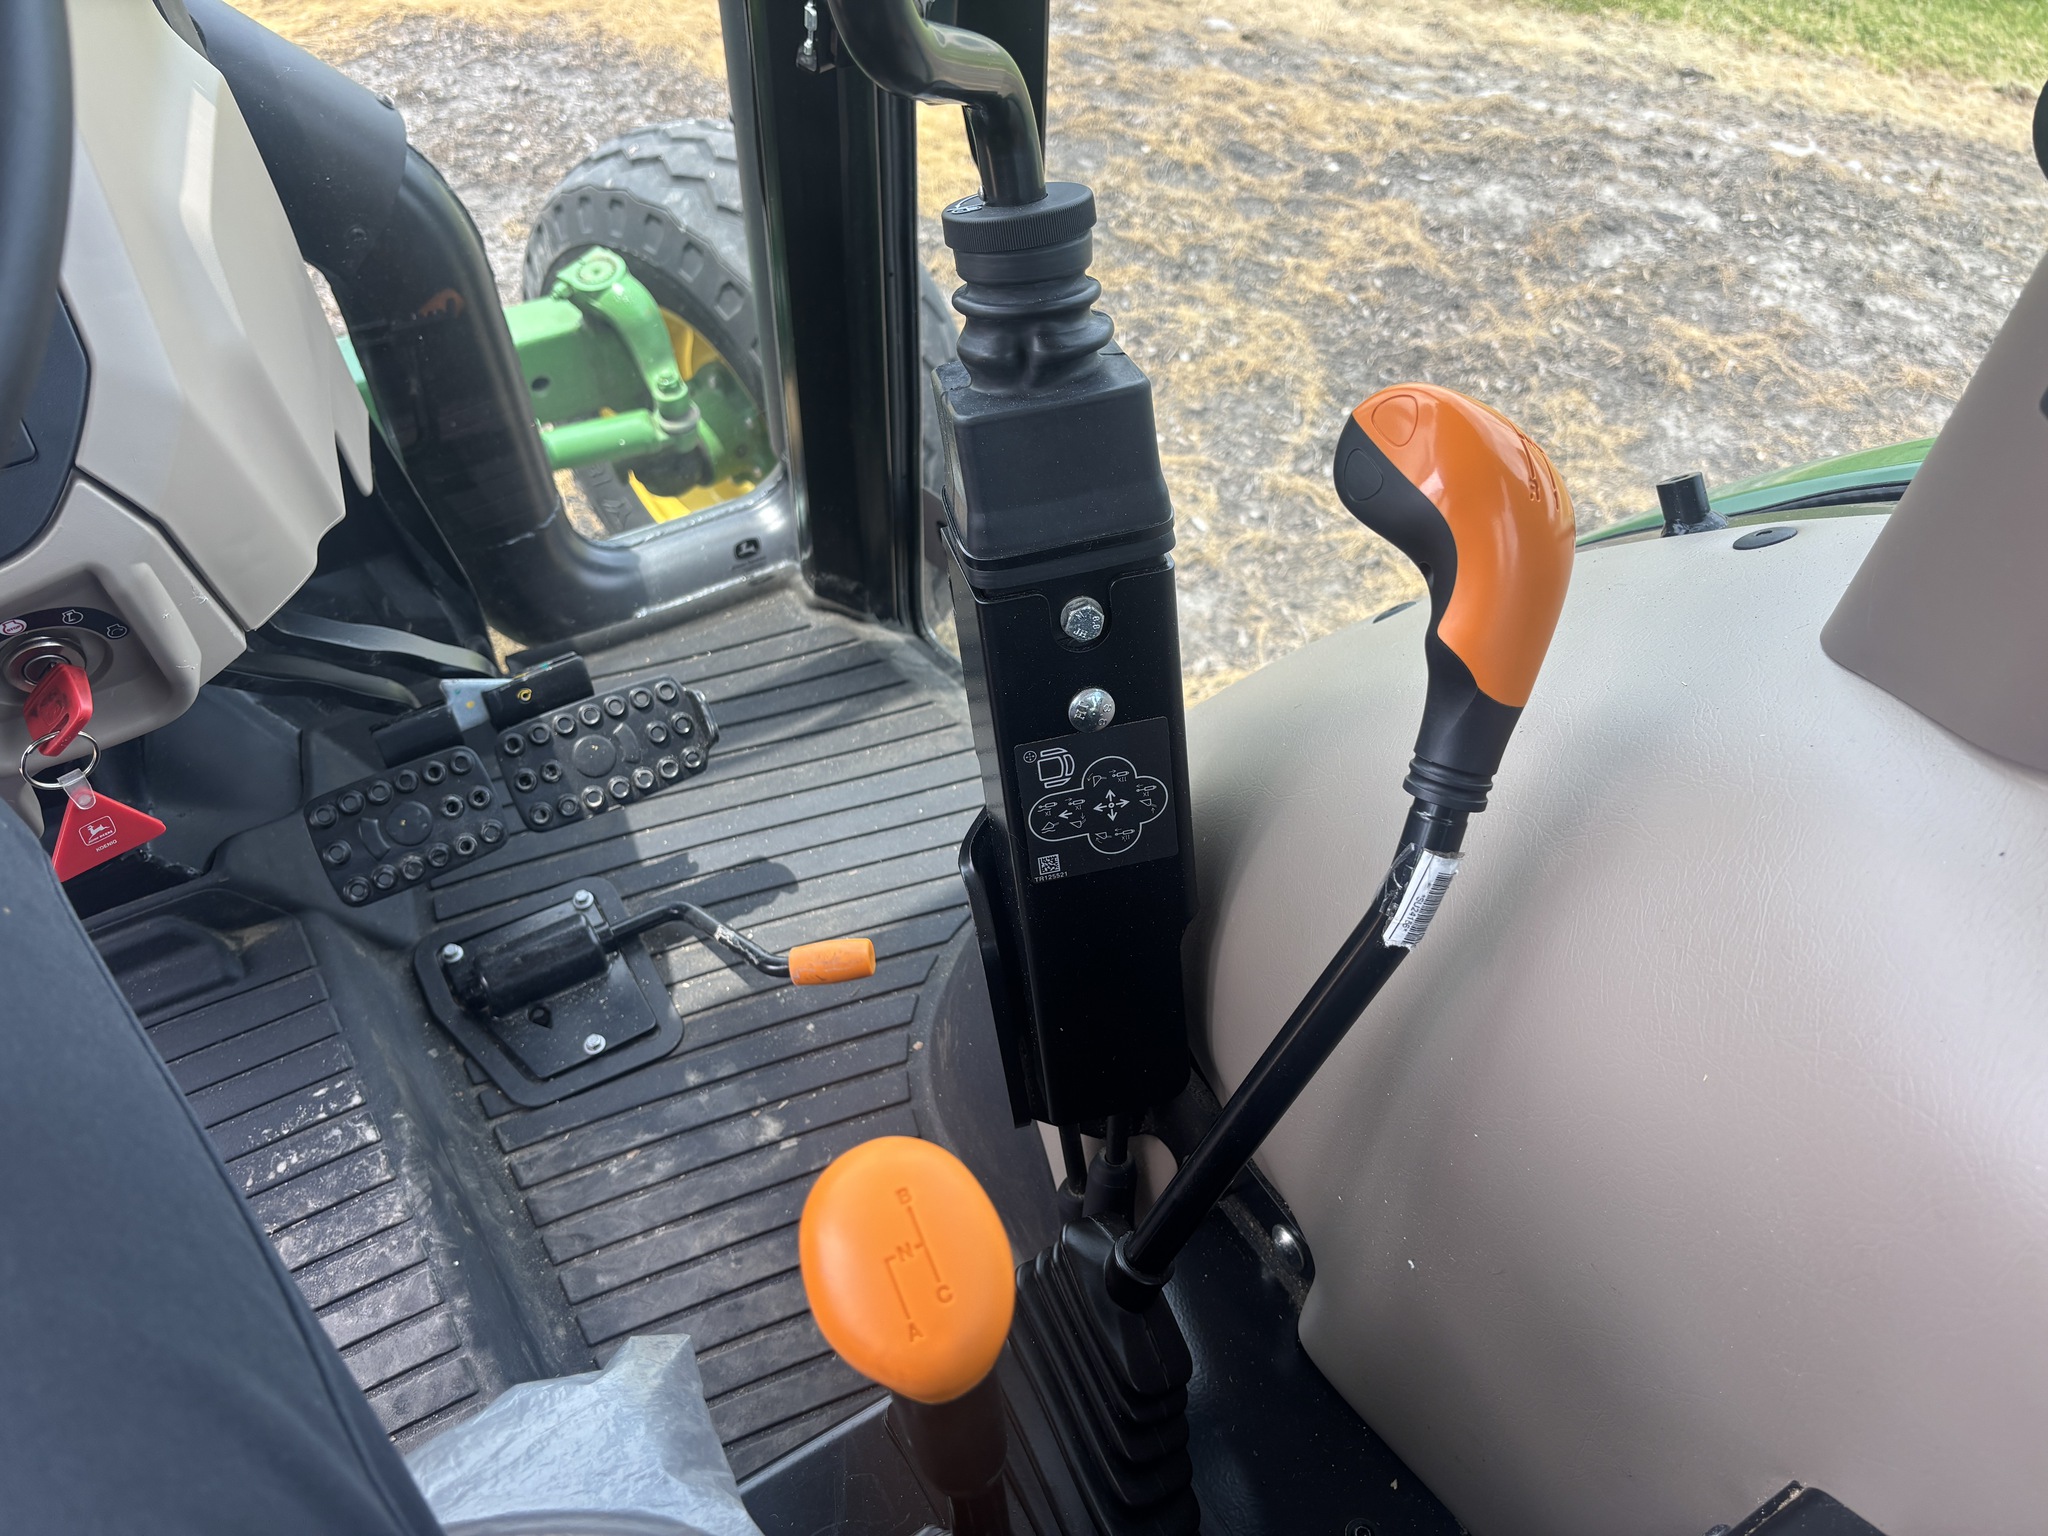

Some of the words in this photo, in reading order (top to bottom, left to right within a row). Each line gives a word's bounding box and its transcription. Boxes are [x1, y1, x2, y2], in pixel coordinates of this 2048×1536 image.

[895, 1187, 912, 1205] B
[896, 1242, 914, 1262] N
[936, 1285, 953, 1303] C
[908, 1322, 924, 1342] A
